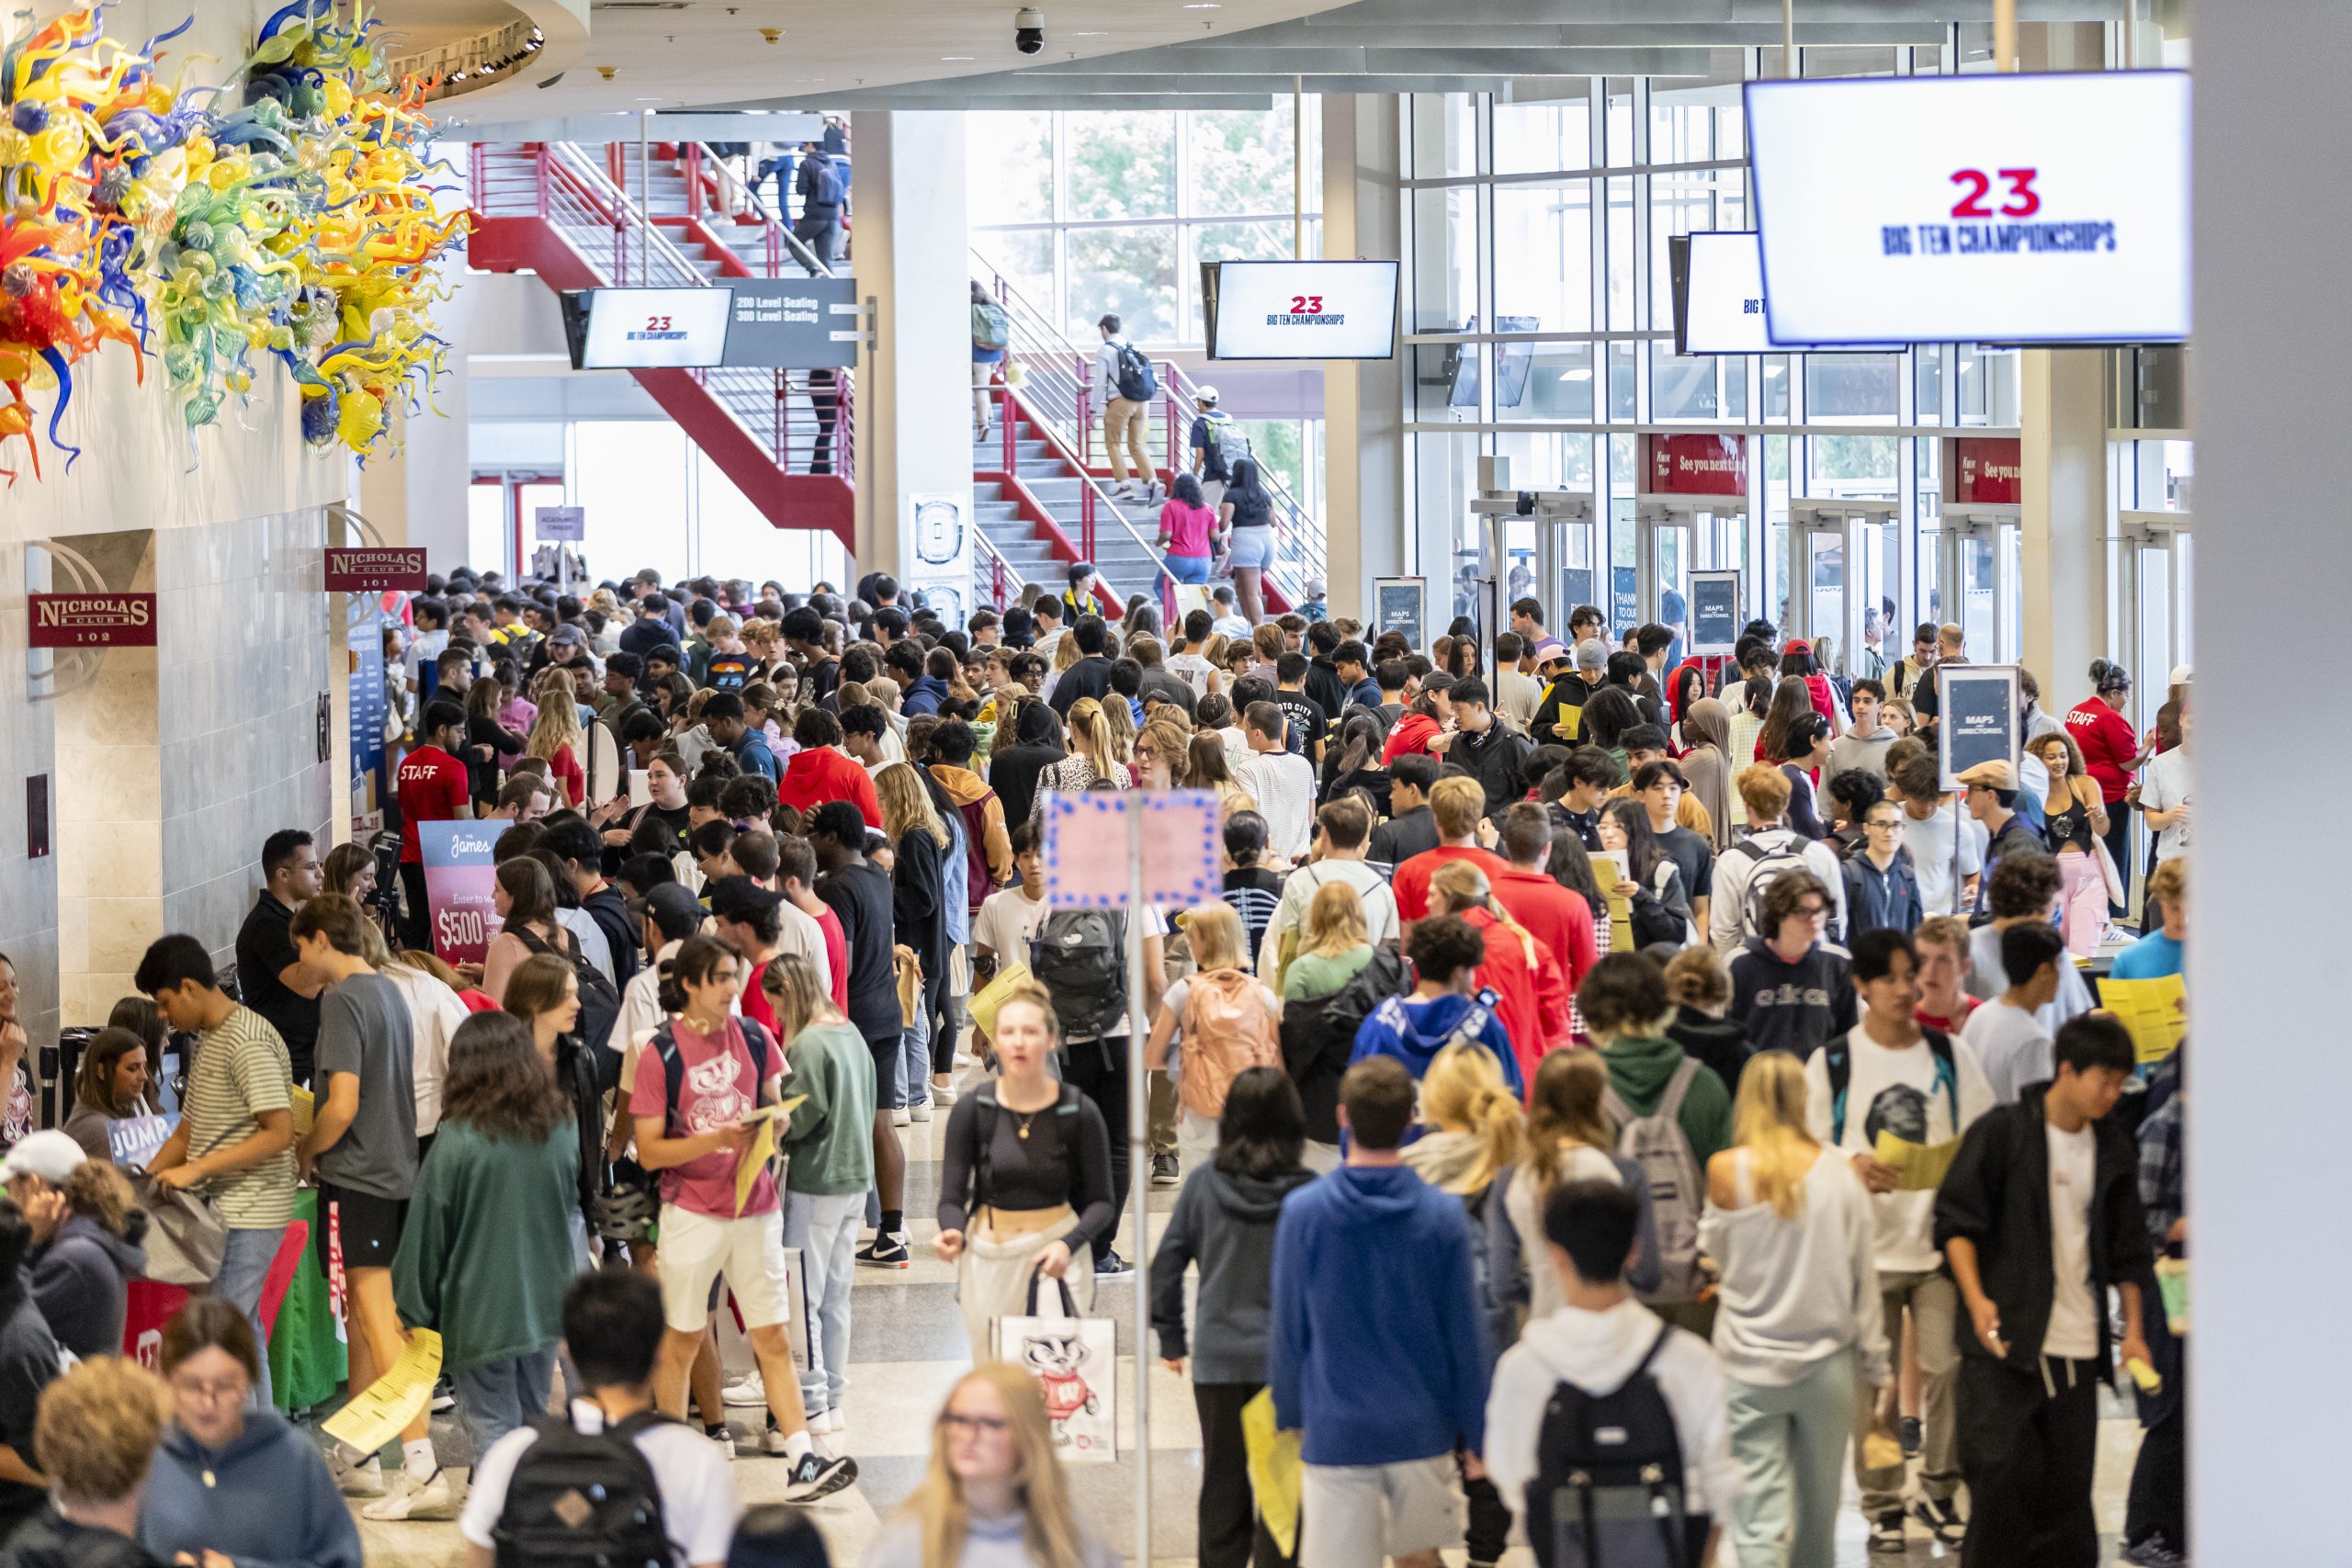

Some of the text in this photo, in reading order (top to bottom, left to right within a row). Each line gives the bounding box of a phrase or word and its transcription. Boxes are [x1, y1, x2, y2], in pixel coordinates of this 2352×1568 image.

[1950, 168, 2041, 218] 23
[737, 297, 819, 310] 200 Level Seating
[1290, 296, 1323, 314] 23
[1744, 299, 1758, 314] BIG
[646, 316, 672, 331] 23
[736, 310, 819, 323] 300 Level Seating
[1267, 314, 1344, 325] BIG TEN CHAMPIONSHIPS
[1679, 456, 1693, 470] See
[1694, 460, 1709, 475] you
[1710, 459, 1727, 470] next
[1984, 461, 1997, 478] See
[1998, 467, 2012, 482] you
[332, 553, 422, 574] NICHOLAS
[38, 600, 149, 626] NICHOLAS
[1619, 606, 1626, 616] TO
[77, 632, 110, 642] 102
[1294, 703, 1312, 716] CITY
[1965, 716, 1995, 724] MAPS
[2066, 710, 2098, 726] STAFF
[401, 765, 439, 780] STAFF
[451, 834, 492, 859] James
[453, 894, 473, 905] Enter
[475, 895, 483, 904] to
[438, 908, 483, 952] $500
